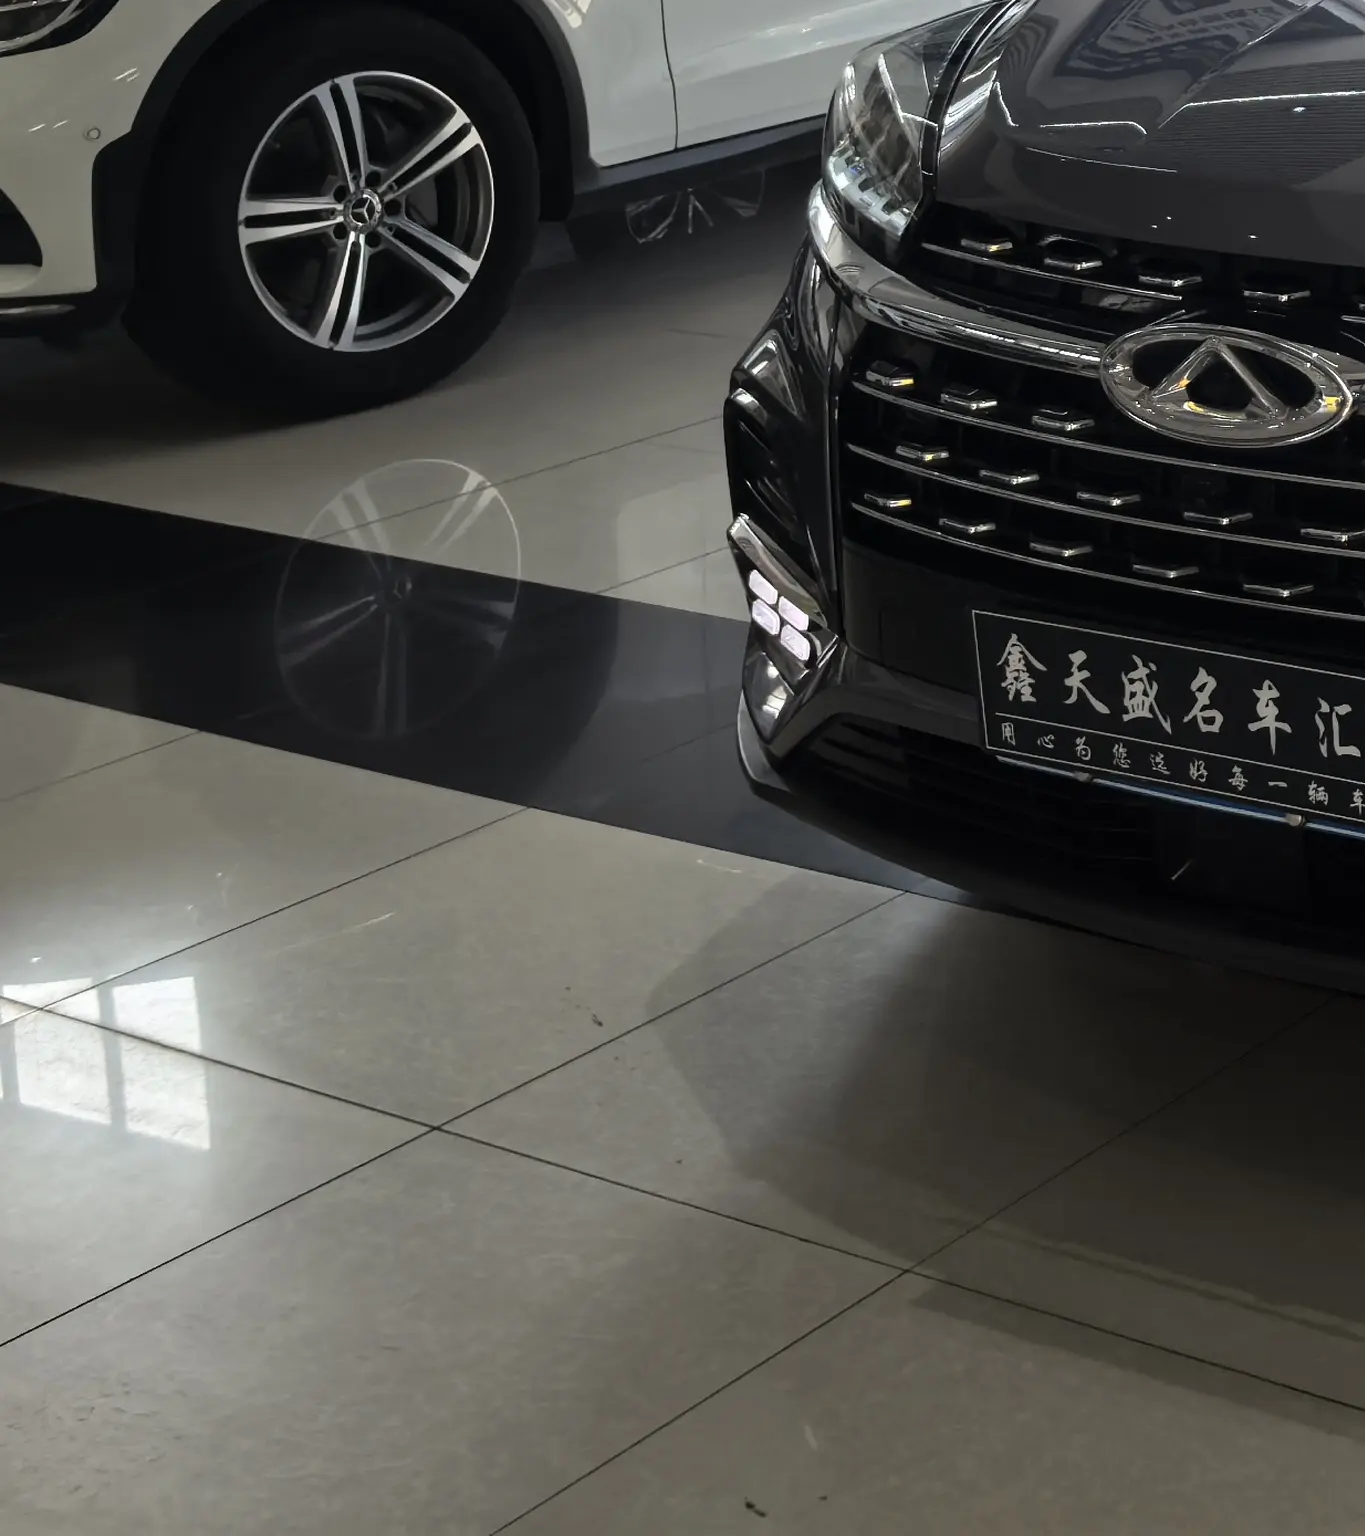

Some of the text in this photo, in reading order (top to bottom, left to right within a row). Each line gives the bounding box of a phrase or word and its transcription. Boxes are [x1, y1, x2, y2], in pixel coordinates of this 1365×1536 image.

[996, 632, 1362, 757] 鑫天盛名车汇
